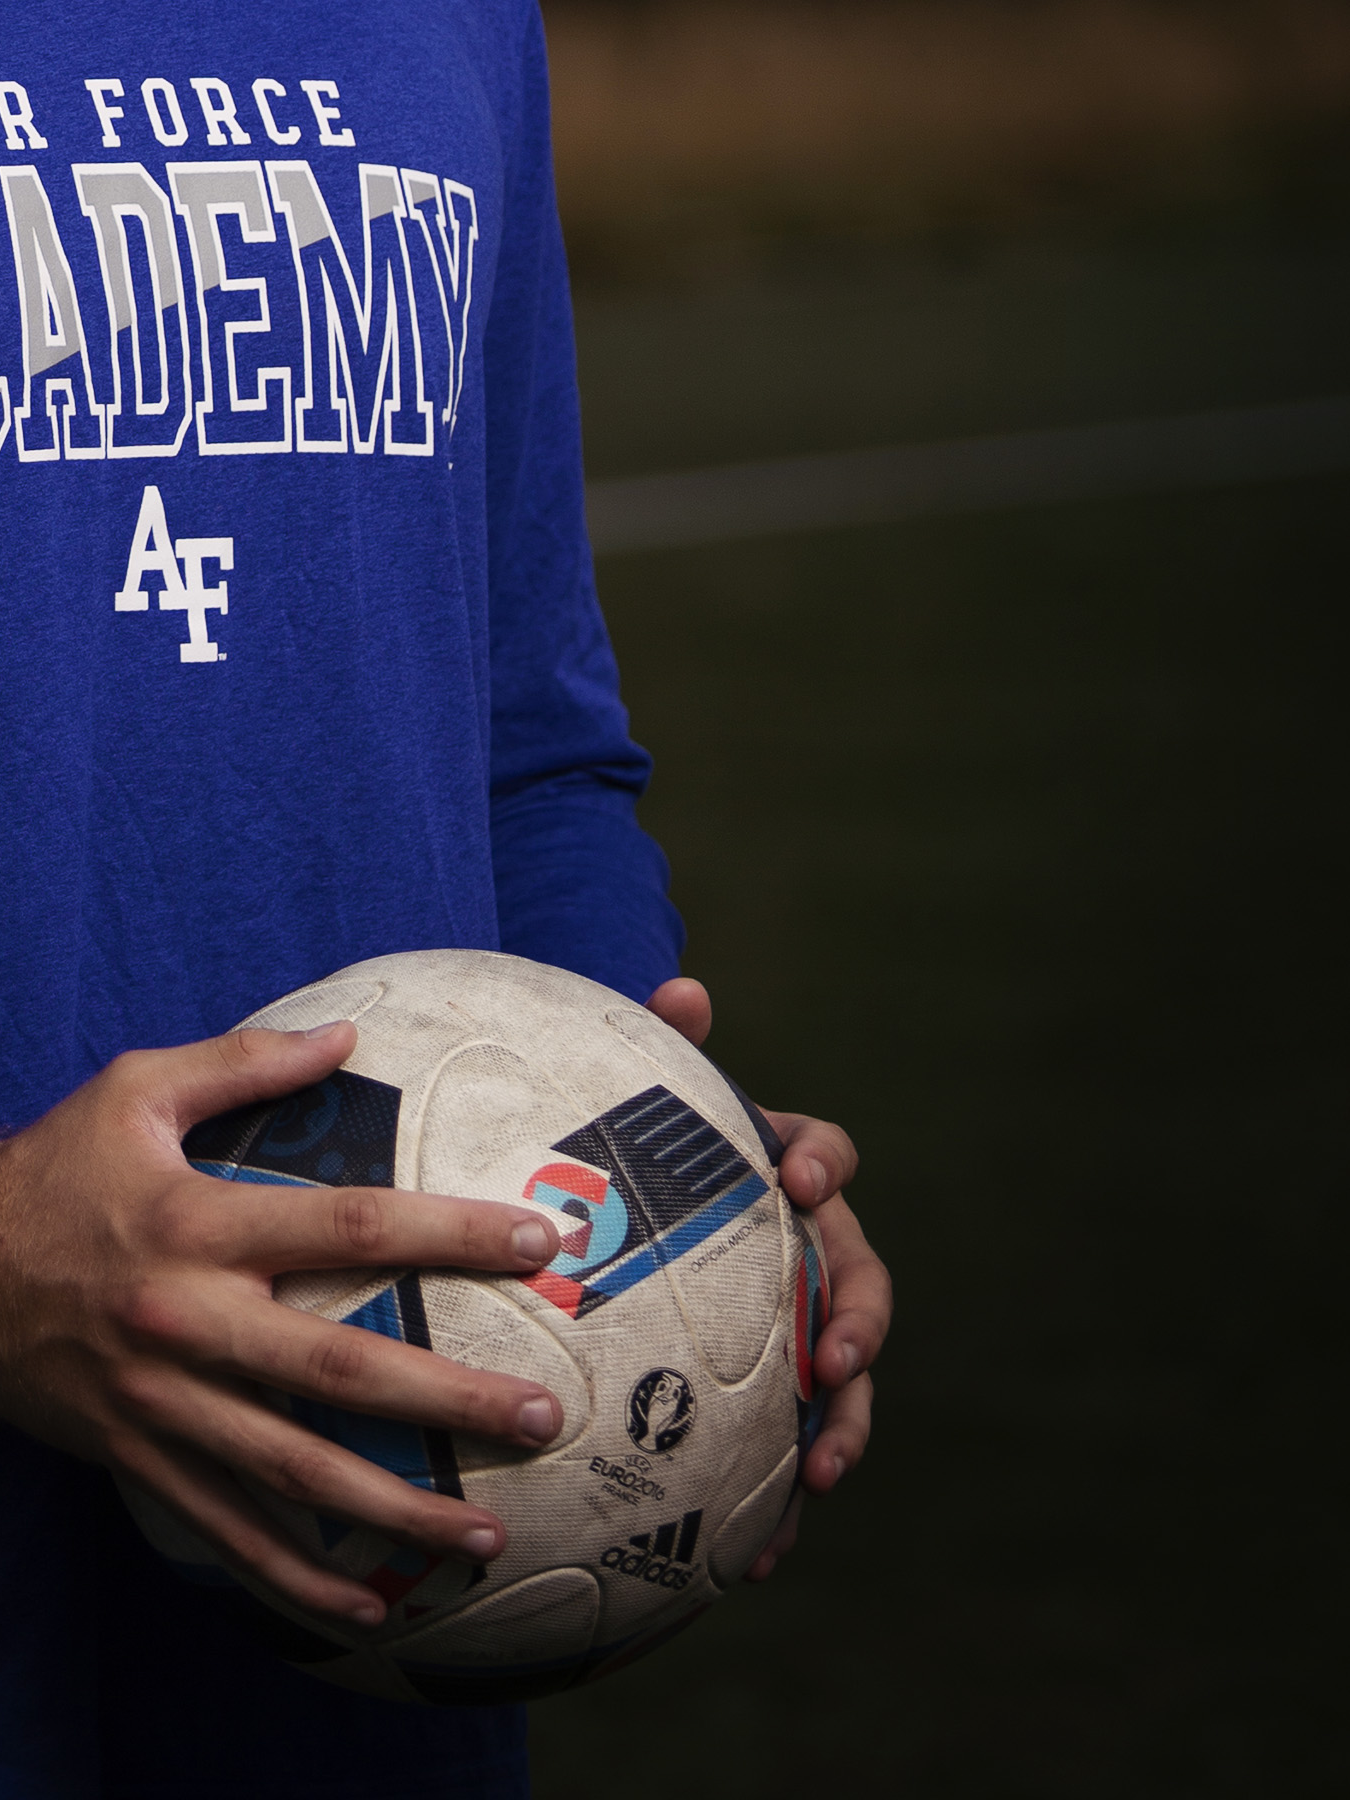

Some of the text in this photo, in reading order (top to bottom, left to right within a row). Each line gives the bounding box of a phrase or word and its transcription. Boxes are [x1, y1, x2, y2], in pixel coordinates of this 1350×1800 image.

[84, 78, 356, 148] FORCE
[115, 485, 234, 663] AF
[601, 1482, 641, 1506] FRANCE
[600, 1546, 692, 1590] adidas
